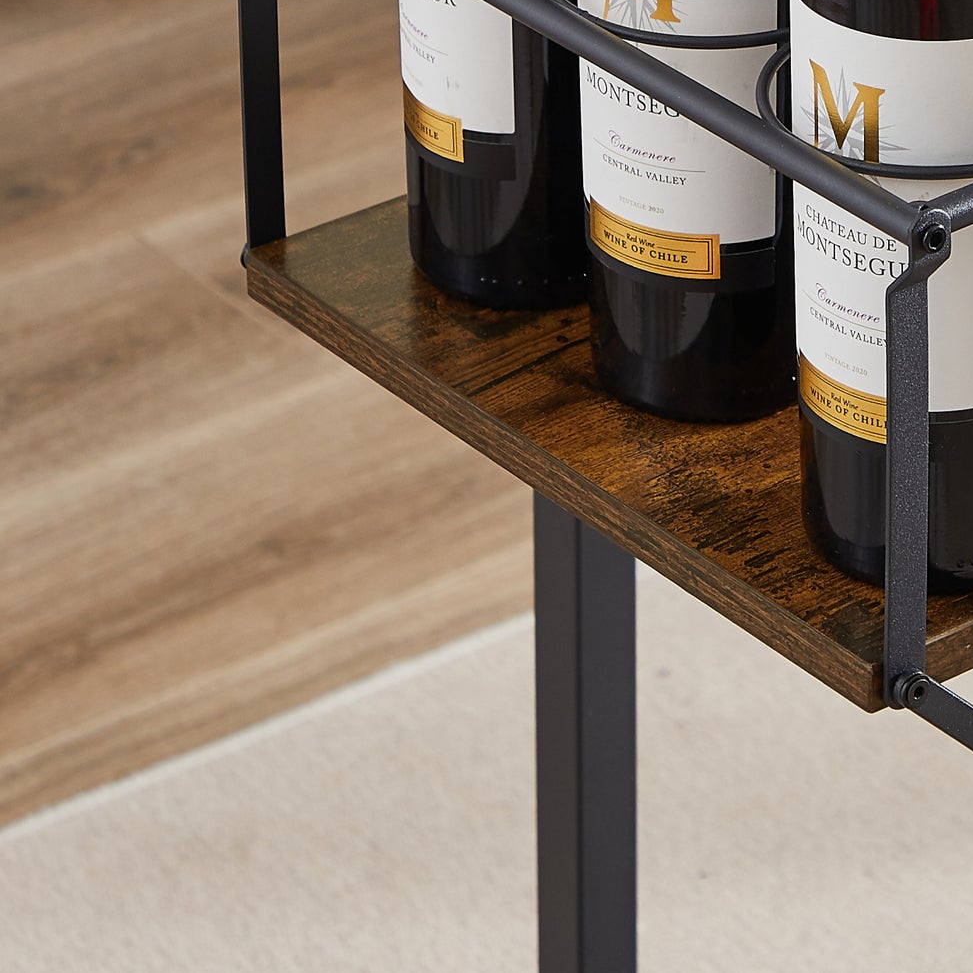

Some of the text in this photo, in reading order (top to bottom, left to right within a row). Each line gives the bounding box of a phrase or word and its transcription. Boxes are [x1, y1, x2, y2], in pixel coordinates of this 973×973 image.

[809, 58, 885, 164] M
[608, 129, 677, 164] Carmenere
[602, 153, 687, 186] CENTRAL VALLEY
[626, 232, 656, 248] Red Wine
[806, 205, 897, 252] CHATEAU DE
[603, 230, 688, 264] WINE OF CHILE
[797, 213, 906, 279] MONTSEGU
[815, 282, 880, 323] Carmenere
[809, 307, 847, 335] CENTRAL
[852, 366, 868, 376] 2020
[810, 387, 832, 409] WINE
[835, 405, 849, 416] OF
[831, 392, 859, 410] Red Wine
